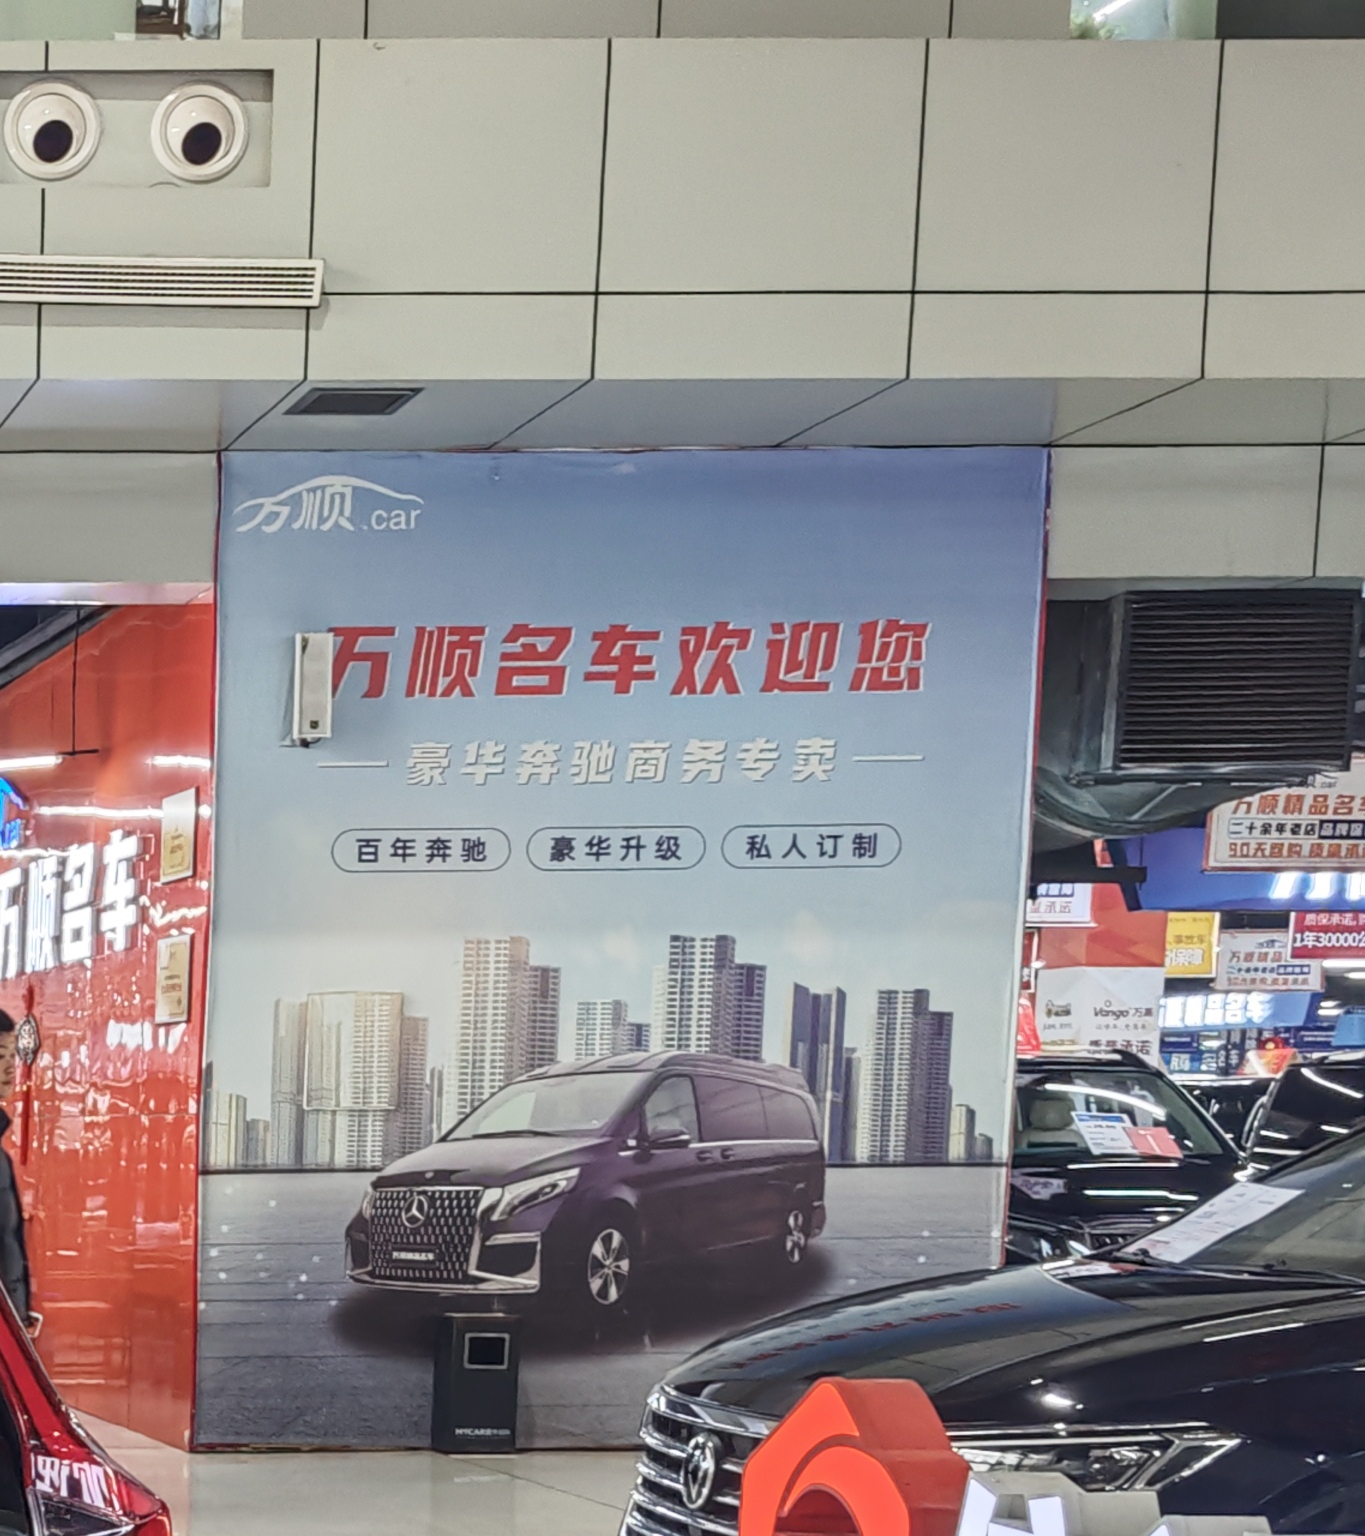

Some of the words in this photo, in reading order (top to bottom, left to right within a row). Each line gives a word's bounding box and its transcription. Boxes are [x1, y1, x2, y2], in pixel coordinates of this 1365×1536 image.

[329, 619, 932, 699] 万顺名车欢迎您
[405, 738, 838, 786] 豪华奔驰商务专卖
[1230, 822, 1318, 836] 二十余年老店
[355, 836, 489, 865] 百年奔驰
[549, 835, 684, 863] 豪华升级
[745, 833, 878, 862] 私人订制
